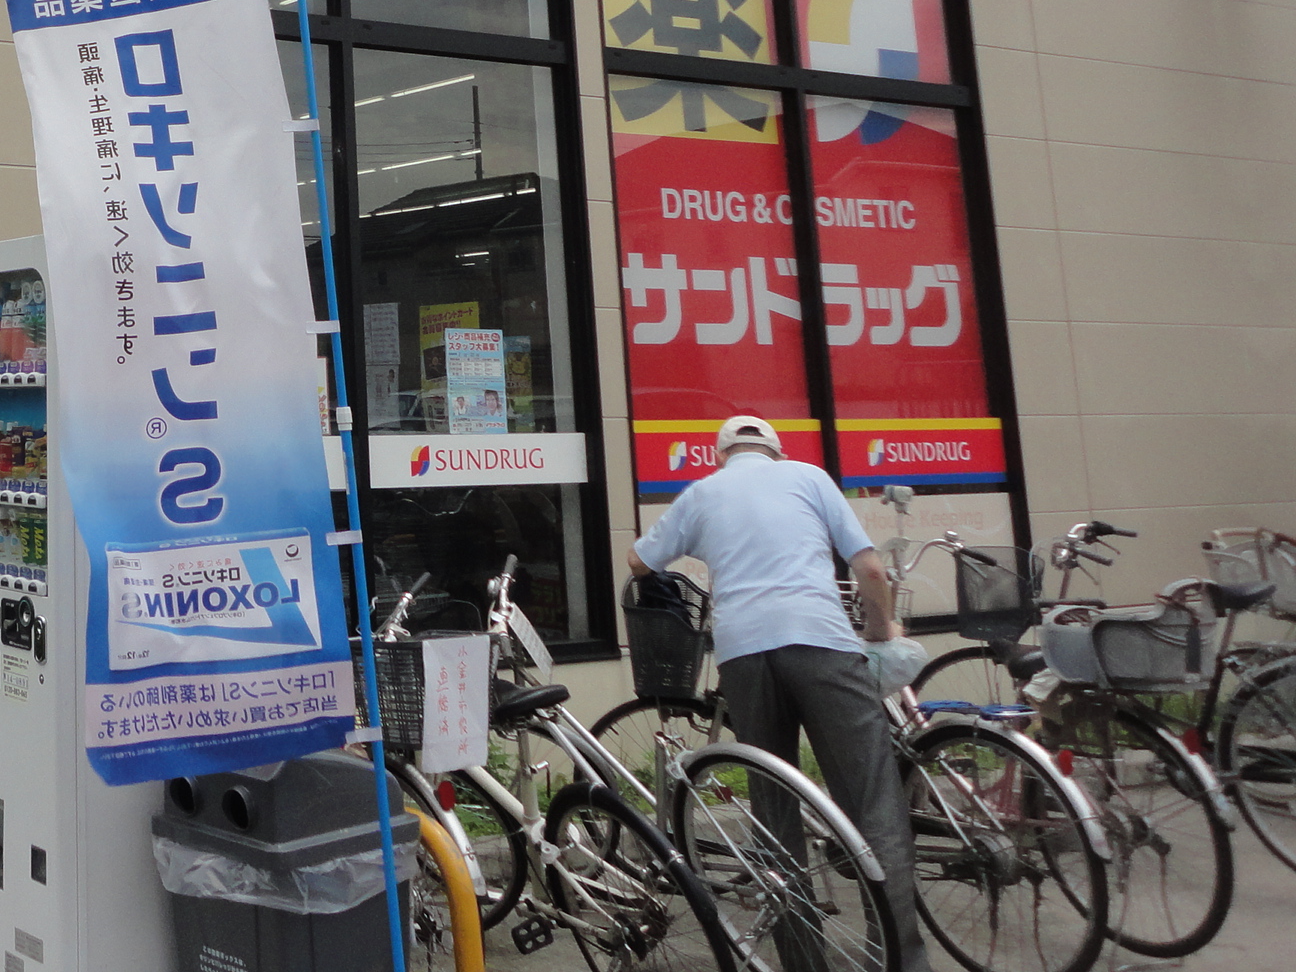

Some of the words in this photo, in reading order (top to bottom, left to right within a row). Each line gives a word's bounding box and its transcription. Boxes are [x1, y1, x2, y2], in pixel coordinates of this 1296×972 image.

[776, 194, 916, 230] CSMETIC
[622, 251, 963, 347] サンドラッグ
[435, 448, 544, 471] SUNDRUG
[887, 441, 970, 462] SUNDRUG
[864, 511, 916, 529] Houe
